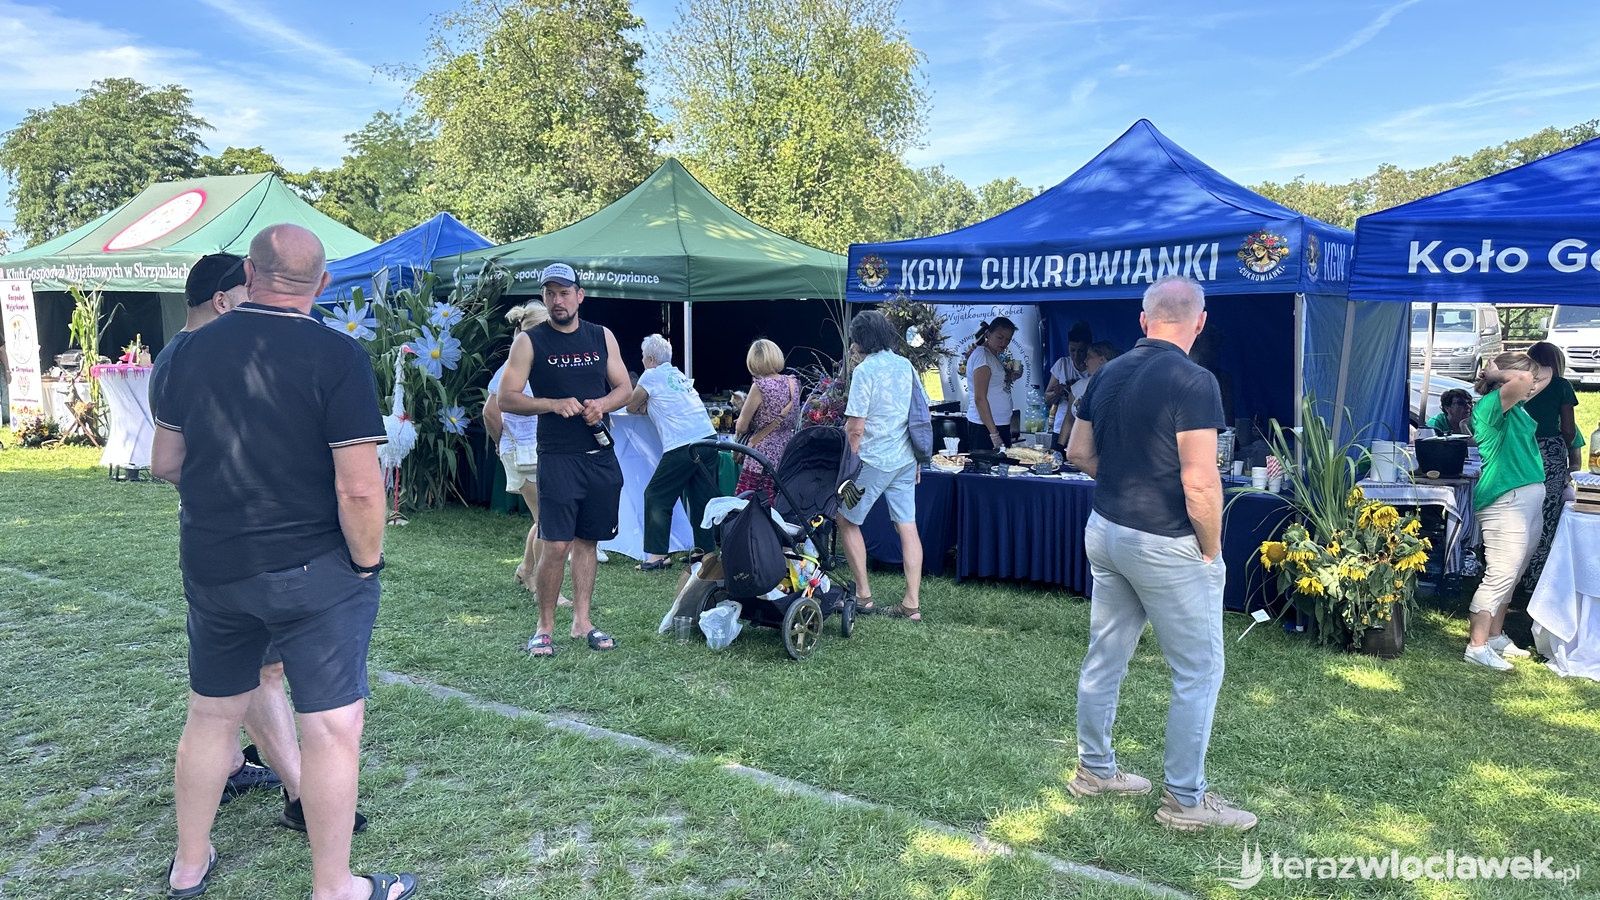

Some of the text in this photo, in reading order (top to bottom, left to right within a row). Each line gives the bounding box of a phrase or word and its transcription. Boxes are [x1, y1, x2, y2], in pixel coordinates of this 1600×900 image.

[1324, 241, 1346, 281] KGW
[1407, 239, 1529, 274] Koło
[6, 262, 189, 282] Klub Gospodyń Wyjątkowych w Skrzynkach
[900, 242, 1220, 291] KGW CUKROWIANKI
[1239, 264, 1285, 282] CUKROWIANKI
[596, 272, 606, 281] w
[606, 271, 660, 285] Cypriance
[999, 304, 1025, 318] Kobiet
[547, 351, 600, 365] GUESS
